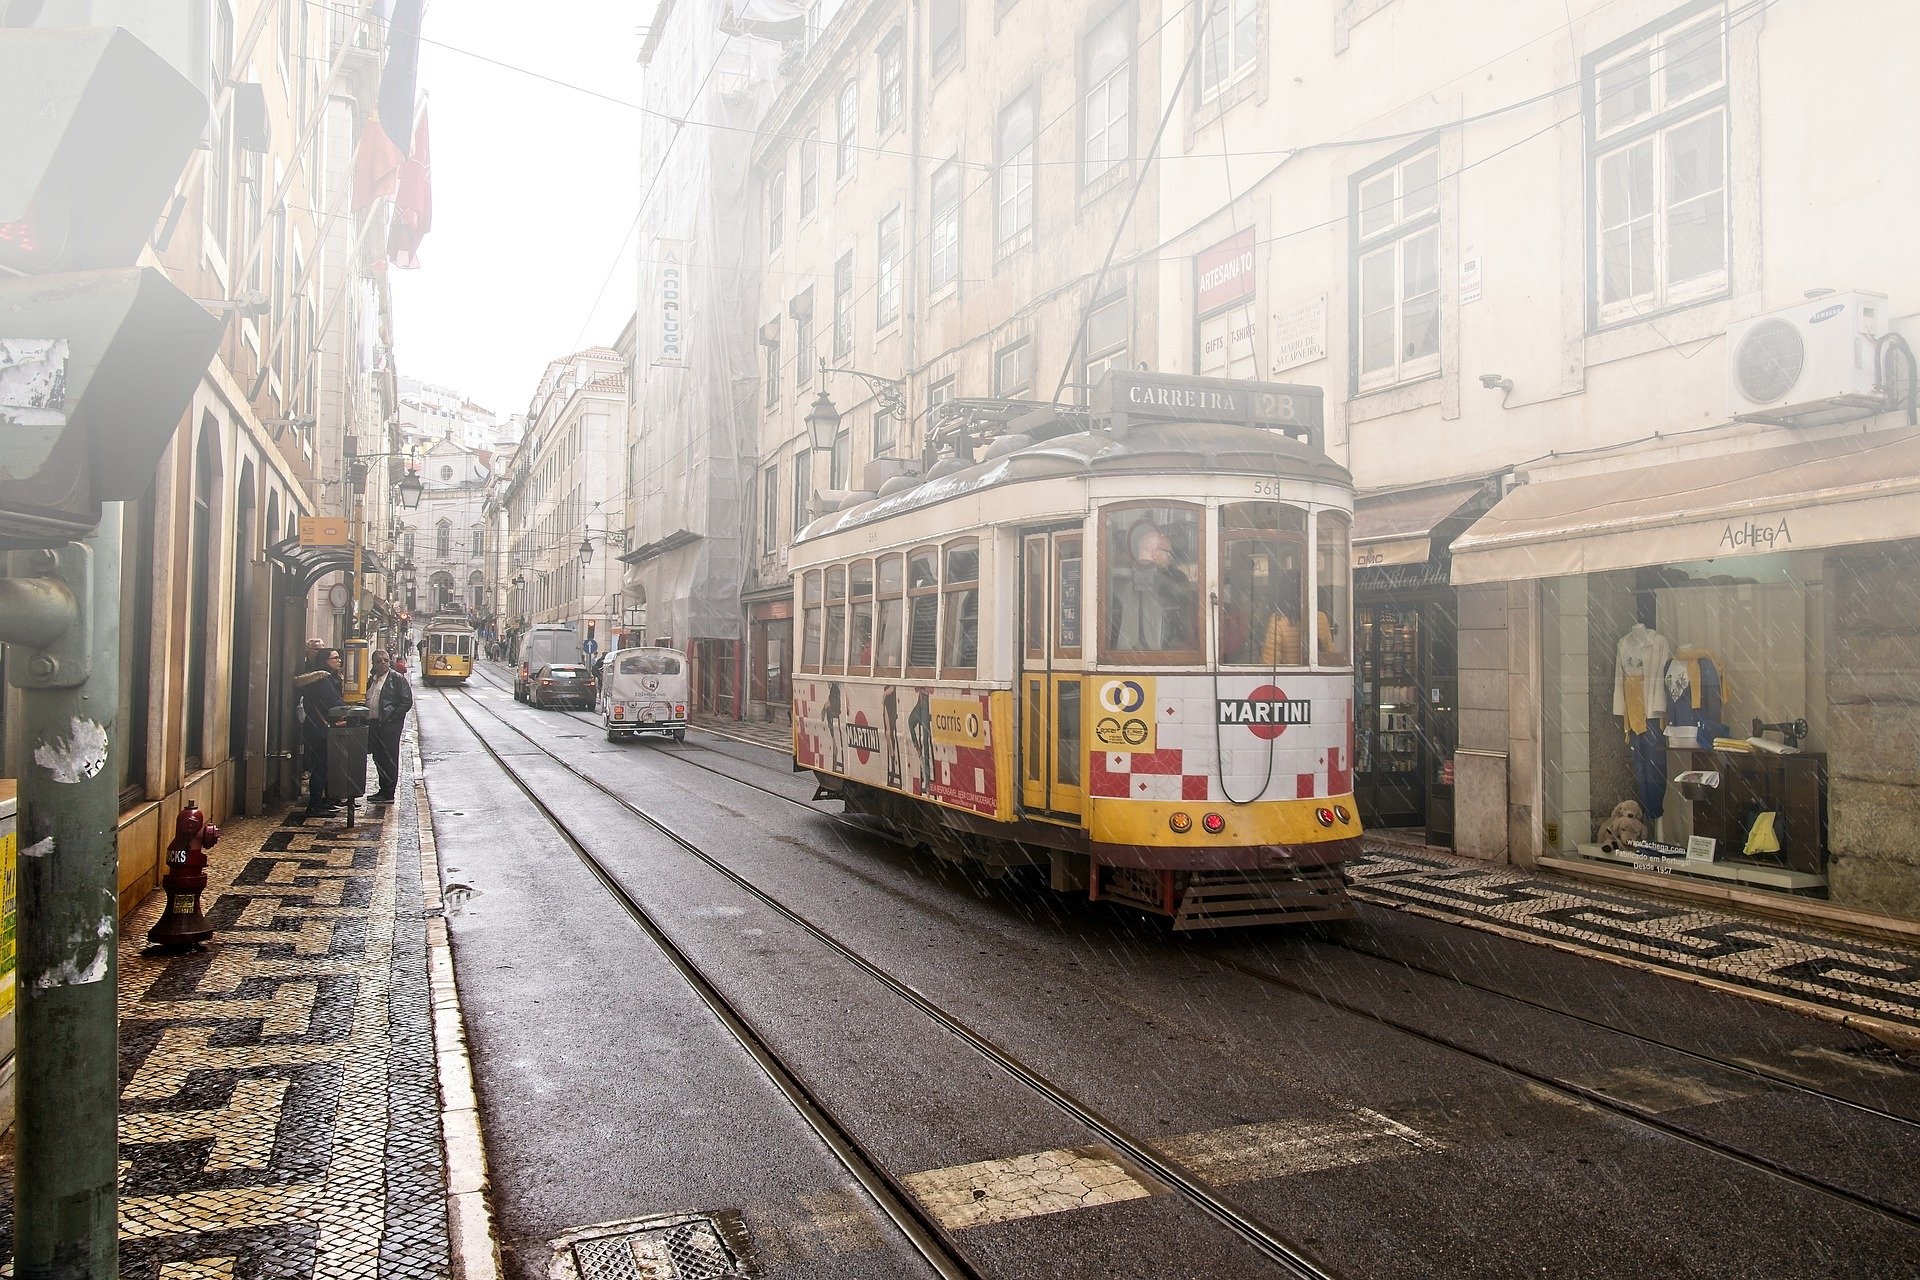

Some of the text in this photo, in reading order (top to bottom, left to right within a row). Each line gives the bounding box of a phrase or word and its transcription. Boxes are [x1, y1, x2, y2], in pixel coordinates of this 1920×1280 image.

[1230, 322, 1256, 344] T-SHIRTS
[1205, 336, 1224, 354] GIFTS
[1129, 386, 1236, 411] CARREIRA
[1254, 481, 1280, 496] 568
[1357, 553, 1384, 566] DMC
[936, 710, 962, 733] carris
[1219, 701, 1309, 723] MARTINI
[846, 723, 880, 751] MARTINI
[1615, 849, 1648, 861] Fabricado
[1661, 857, 1691, 868] Portugal
[1633, 861, 1655, 871] Desde
